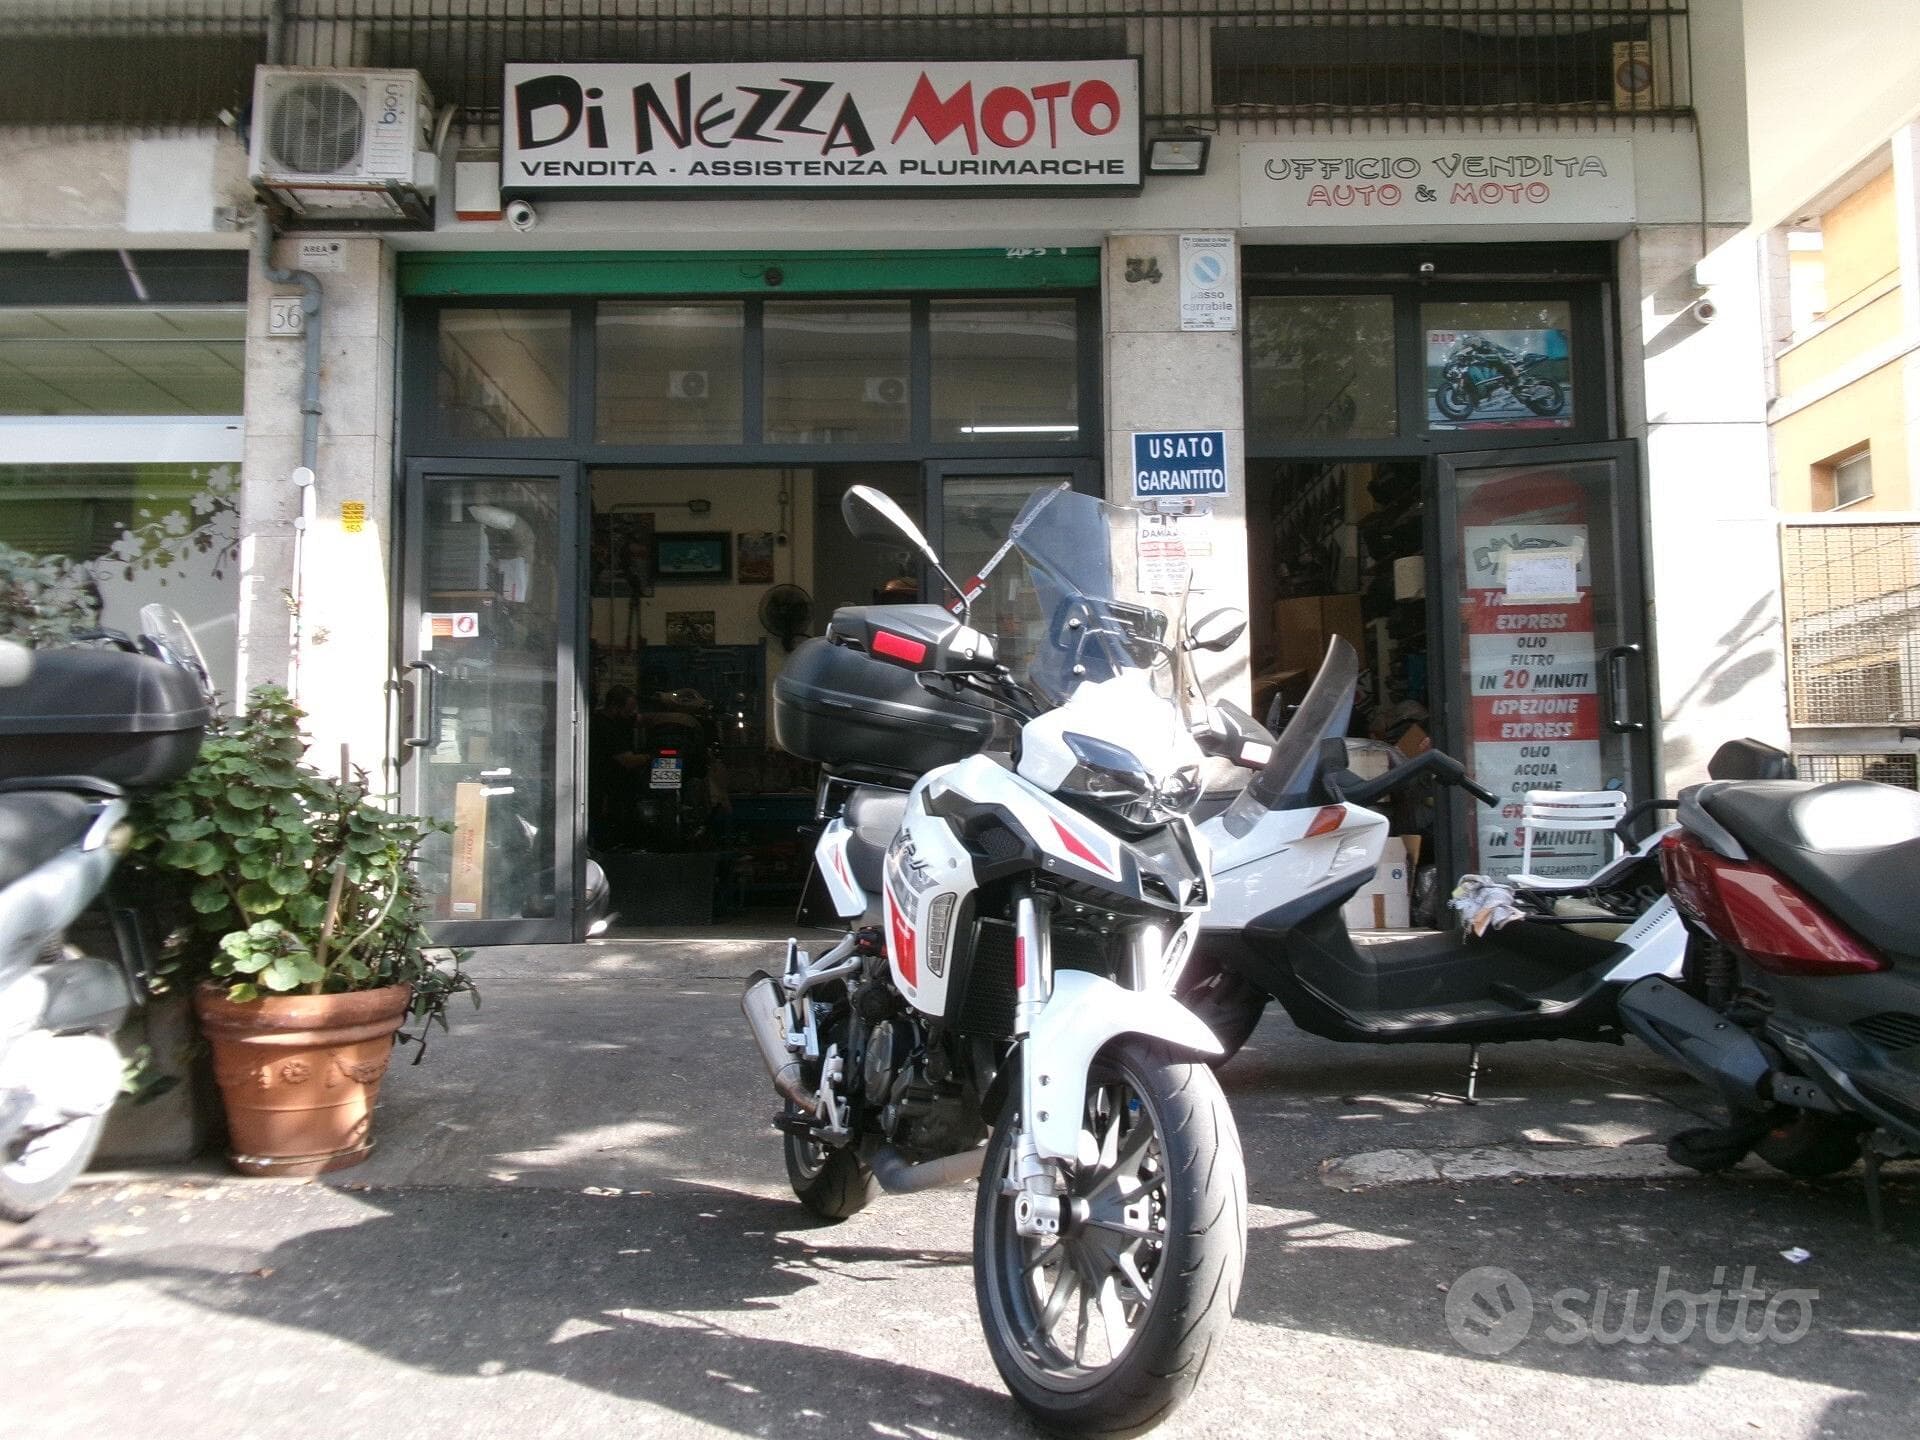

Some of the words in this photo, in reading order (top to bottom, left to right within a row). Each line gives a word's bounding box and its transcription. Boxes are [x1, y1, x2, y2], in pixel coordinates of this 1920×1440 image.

[891, 70, 1121, 156] MOTO
[520, 160, 658, 177] VENDITA
[687, 160, 888, 177] ASSISTENZA
[899, 159, 1125, 176] PLURIMARCHE
[1264, 157, 1421, 180] UFFICIO
[1431, 154, 1607, 179] VENDITA
[1307, 184, 1402, 207] AUTO
[1414, 184, 1438, 202] &
[1450, 181, 1551, 204] MOTO
[1124, 256, 1164, 285] 34
[1182, 301, 1233, 311] carrabile
[271, 303, 302, 328] 36
[1149, 437, 1214, 459] USATO
[1137, 468, 1224, 491] GARANTITO
[1495, 613, 1569, 630] EXPRESS
[1516, 636, 1548, 648] OLIO
[1510, 654, 1555, 666] FILTRO
[1480, 675, 1498, 690] IN
[1503, 669, 1530, 689] 20
[1534, 673, 1589, 689] MINUTI
[1491, 699, 1580, 715] ISPEZIONE
[1501, 722, 1575, 738] EXPRESS
[1519, 746, 1551, 758] OLIO
[1514, 763, 1559, 776] ACQUA
[1511, 781, 1563, 792] GOMME
[1489, 832, 1509, 847] IN
